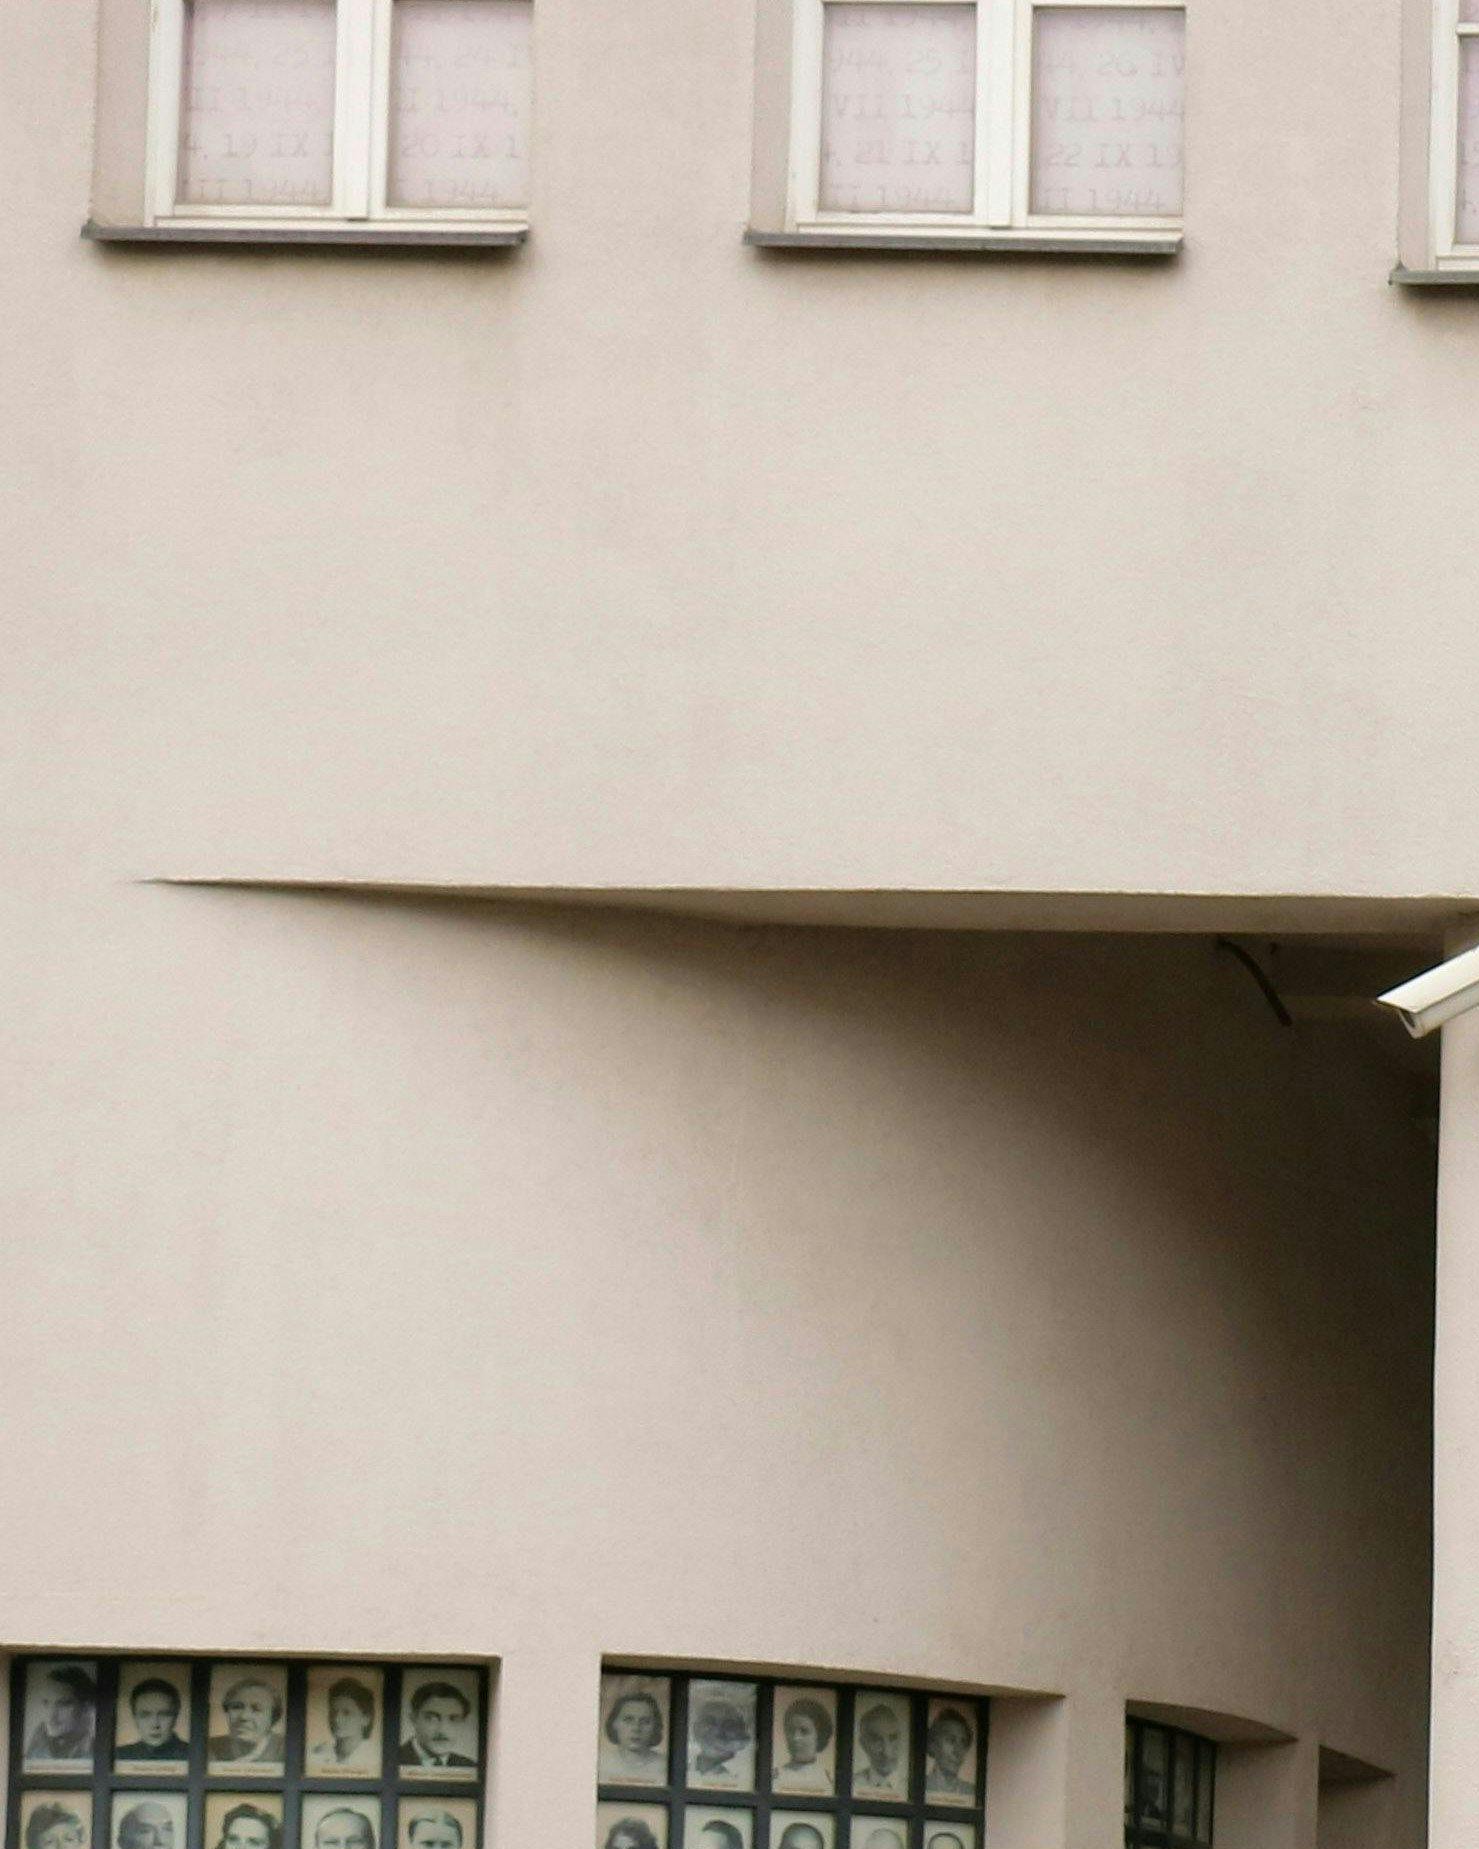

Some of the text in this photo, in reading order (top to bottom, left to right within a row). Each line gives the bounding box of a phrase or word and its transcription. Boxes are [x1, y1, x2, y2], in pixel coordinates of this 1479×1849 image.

[270, 133, 308, 158] IX
[451, 134, 491, 159] IX
[902, 140, 941, 165] IX
[1046, 142, 1132, 168] 22 IX
